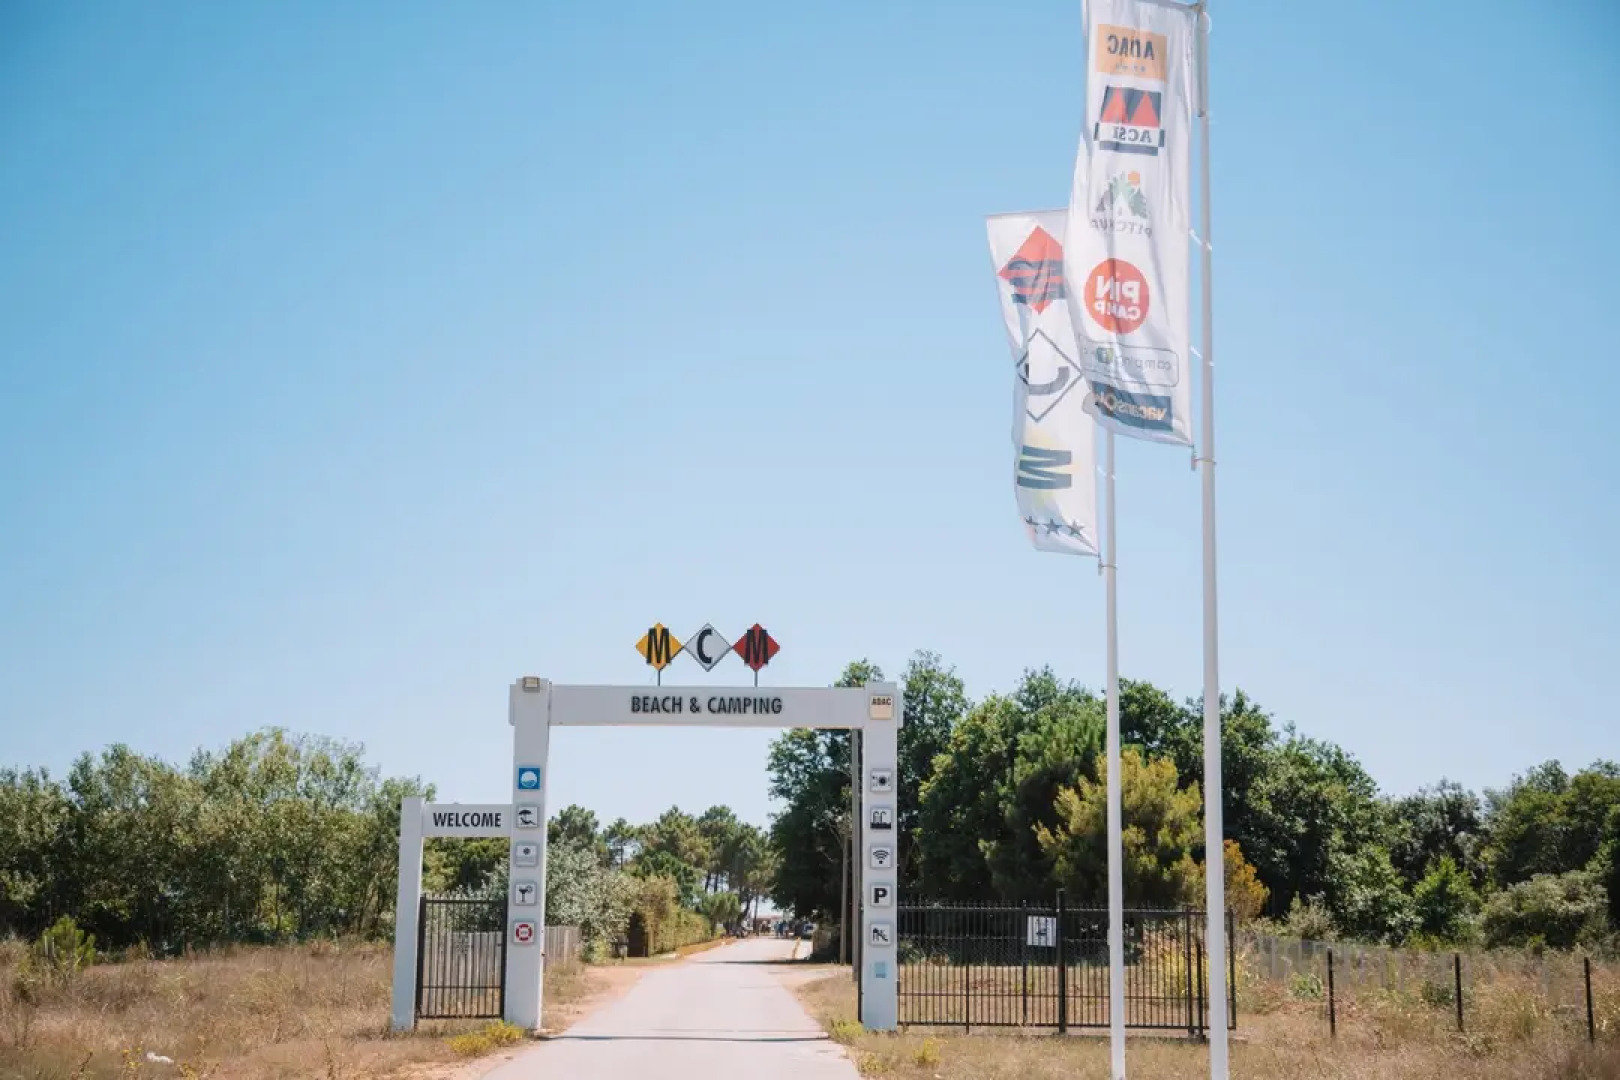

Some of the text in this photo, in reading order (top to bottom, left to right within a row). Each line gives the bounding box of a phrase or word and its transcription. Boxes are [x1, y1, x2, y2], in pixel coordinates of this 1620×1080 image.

[631, 696, 783, 714] BEACH & CAMPING
[433, 812, 502, 828] WELCOME
[873, 887, 888, 904] P
